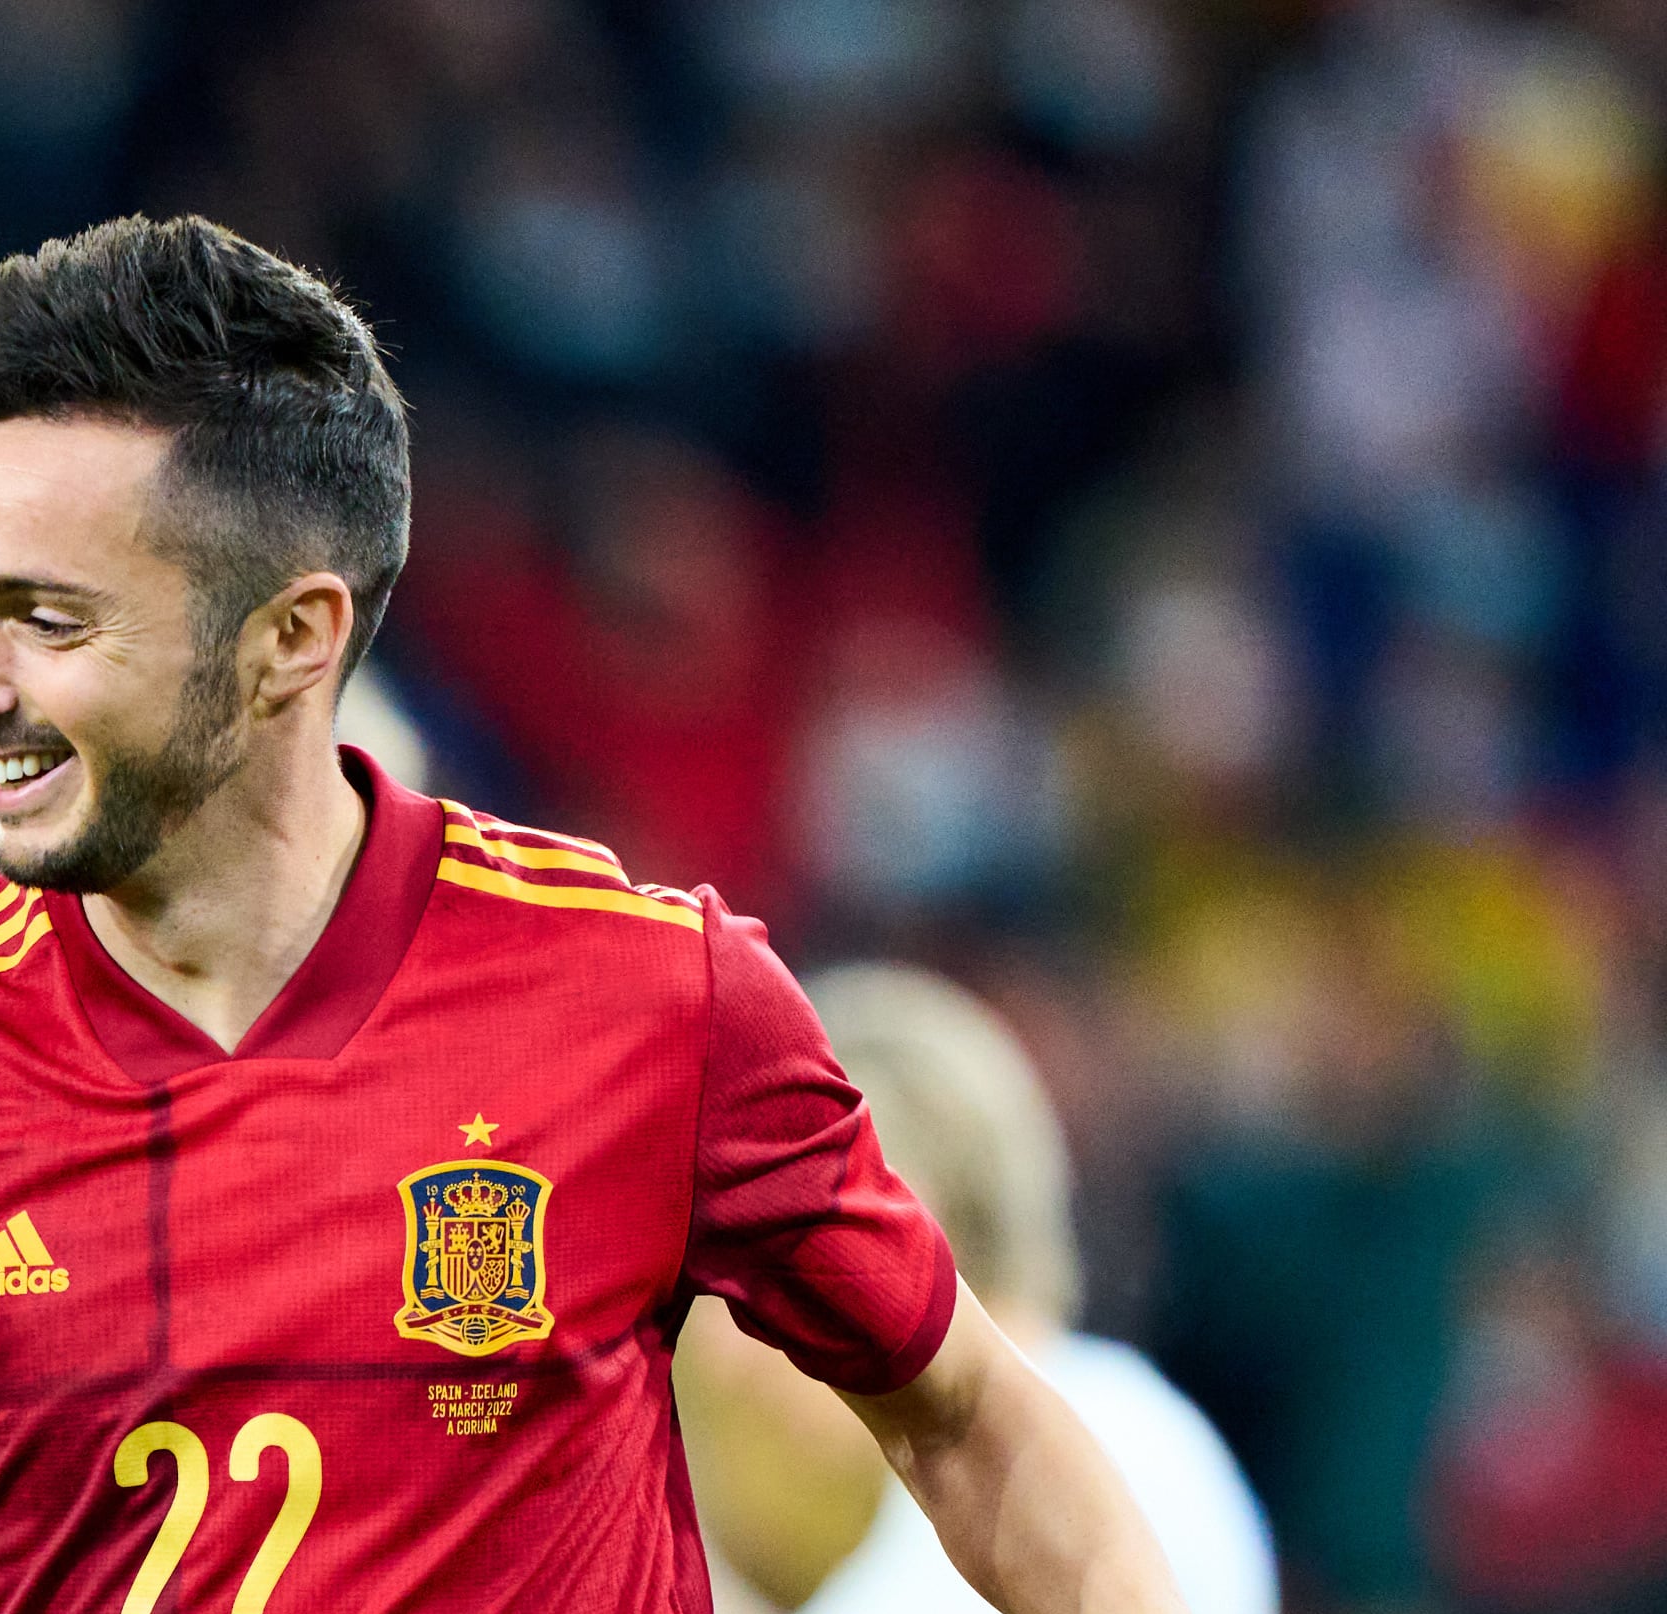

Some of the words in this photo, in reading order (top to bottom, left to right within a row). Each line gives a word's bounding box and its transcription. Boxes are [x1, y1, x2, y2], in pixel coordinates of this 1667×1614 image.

[426, 1185, 439, 1196] 19
[428, 1384, 462, 1401] SPAIN
[471, 1383, 518, 1400] ICELAND
[432, 1402, 446, 1418] 29
[448, 1402, 484, 1418] MARCH
[487, 1400, 513, 1416] 2022
[447, 1420, 454, 1436] A
[456, 1415, 498, 1435] CORUÑA
